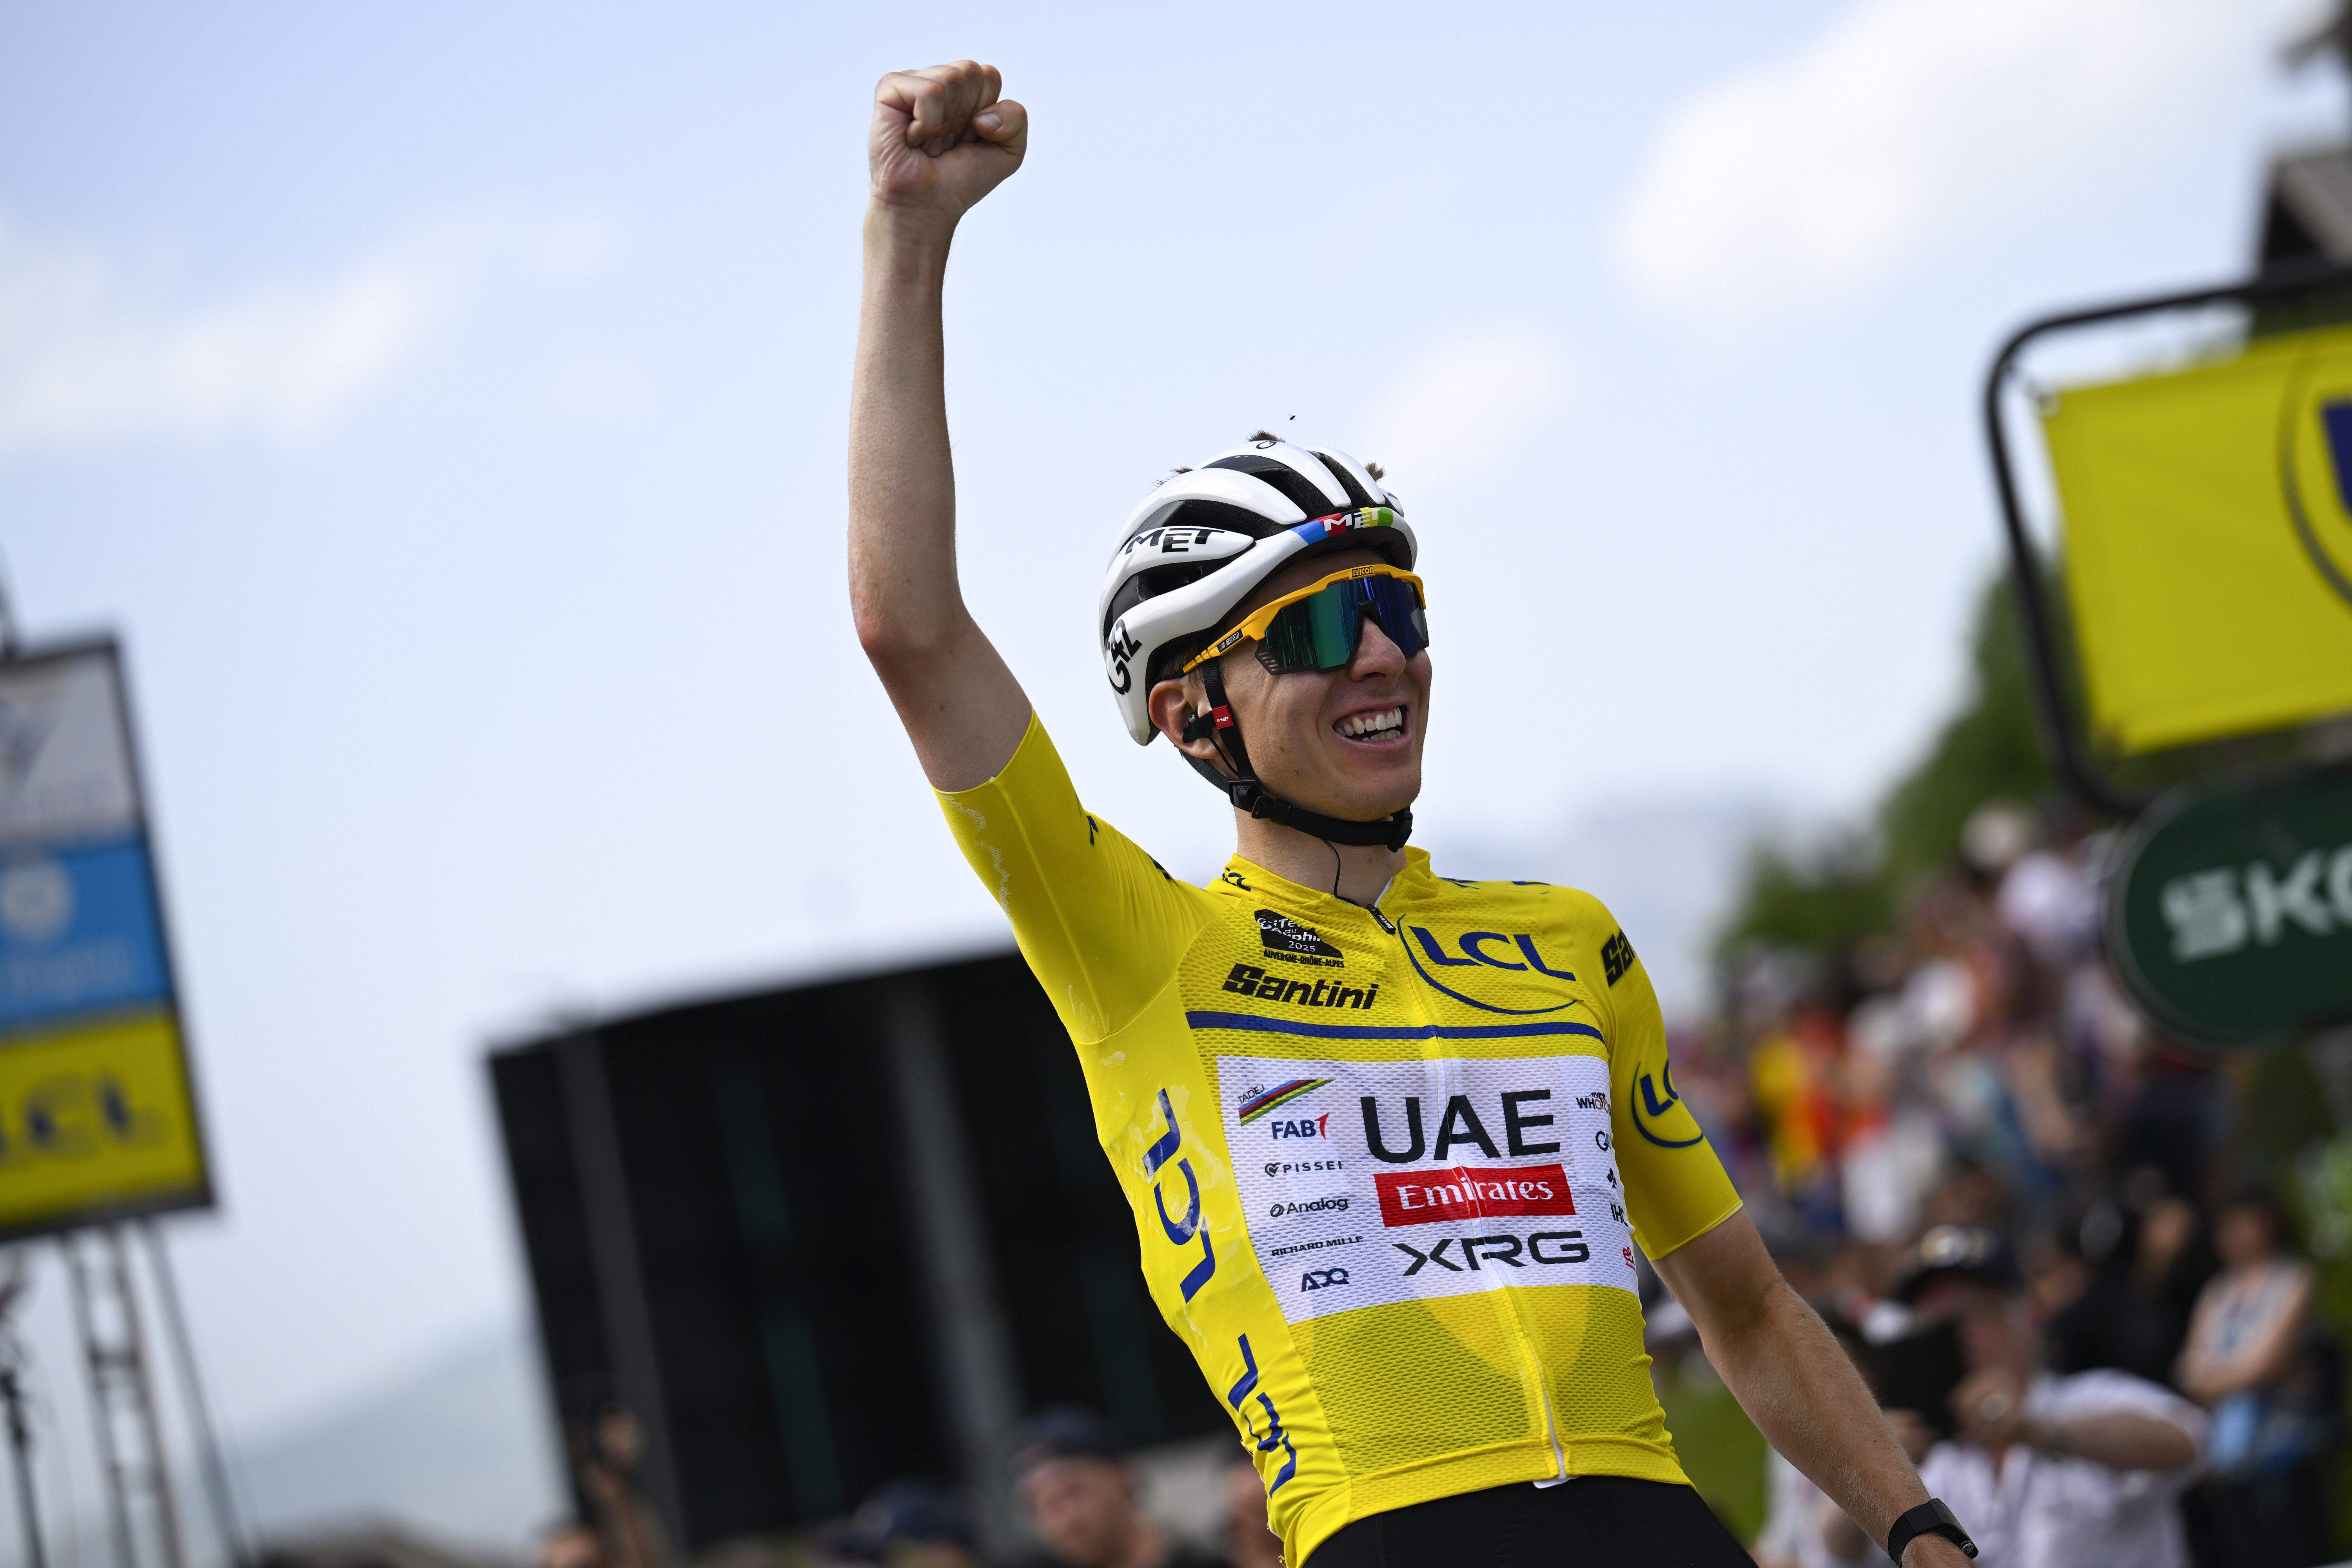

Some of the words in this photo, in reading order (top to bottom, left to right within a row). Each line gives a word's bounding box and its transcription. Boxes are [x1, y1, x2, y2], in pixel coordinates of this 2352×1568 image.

[1323, 508, 1381, 532] MET
[1125, 528, 1225, 555] MET
[1288, 941, 1316, 952] 2025
[1408, 926, 1576, 981] LCL
[1601, 928, 1635, 988] Sa
[1222, 963, 1379, 1009] Santini
[1238, 1084, 1265, 1104] TADEJ
[1360, 1089, 1560, 1163] UAE
[1283, 1161, 1342, 1174] PISSEI
[1142, 1088, 1216, 1304] LCL
[1287, 1198, 1348, 1213] Analog
[1396, 1176, 1554, 1211] Emirates
[1271, 1241, 1324, 1257] RICHARD
[1326, 1236, 1364, 1247] MILLE
[1392, 1230, 1590, 1276] XRG
[1227, 1333, 1297, 1500] LCL
